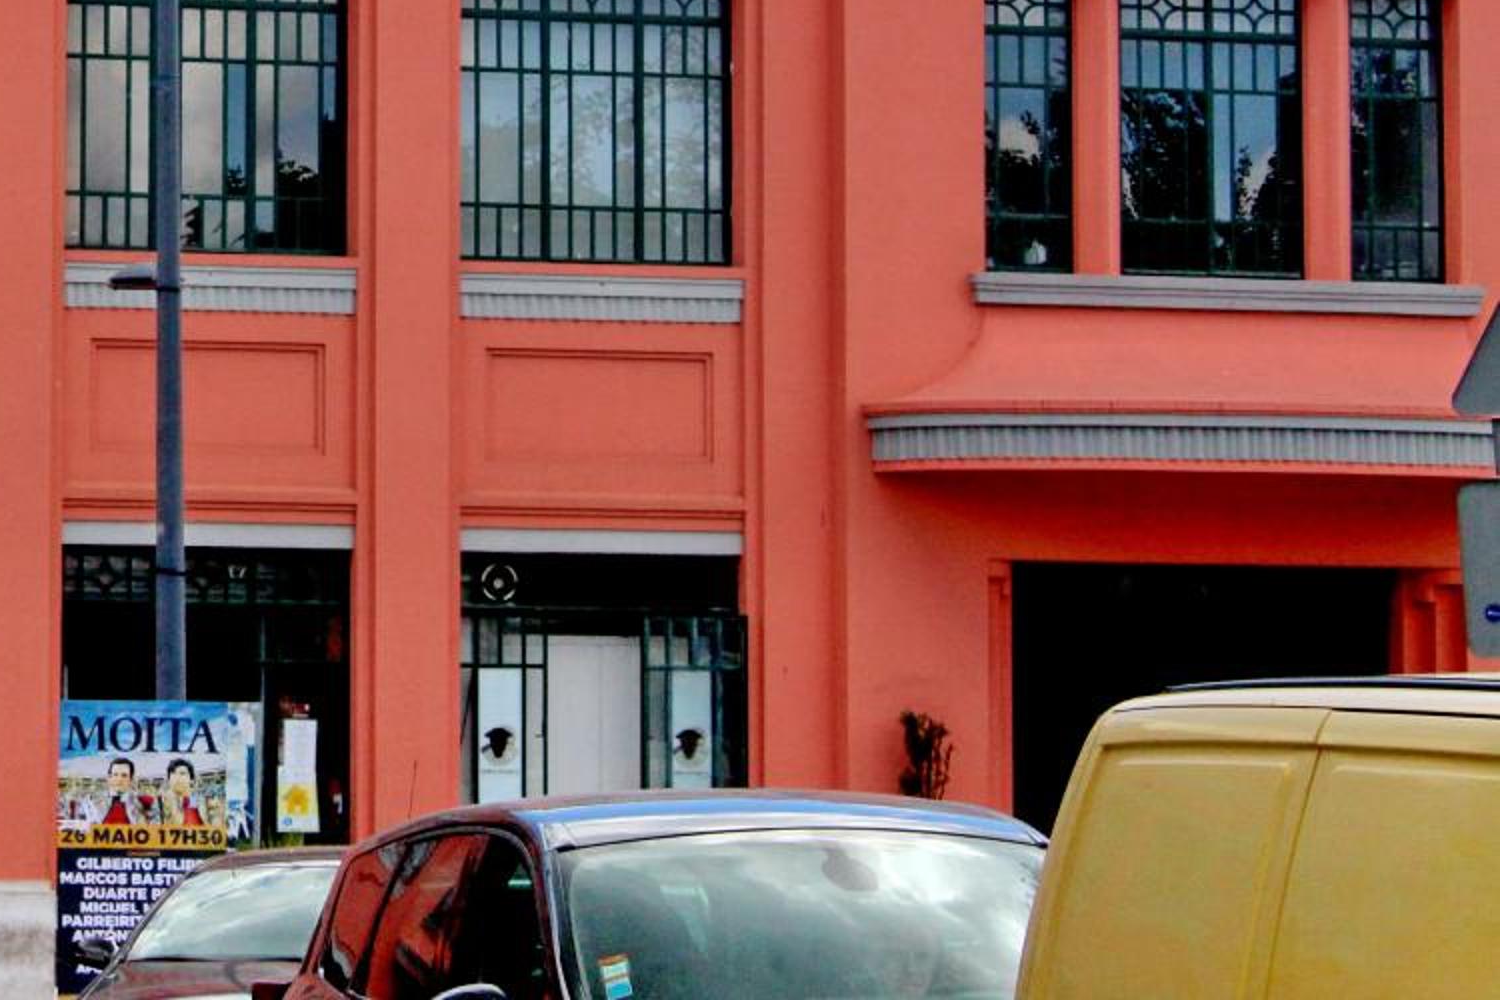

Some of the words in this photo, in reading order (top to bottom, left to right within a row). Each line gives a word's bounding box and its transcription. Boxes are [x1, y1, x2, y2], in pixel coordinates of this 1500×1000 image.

[66, 714, 220, 754] MOITA
[60, 829, 86, 844] 26
[92, 829, 150, 845] MAIO
[158, 829, 224, 845] 17H30
[76, 857, 154, 871] GILBERTO
[59, 872, 128, 885] MARCOS
[83, 887, 148, 901] DUARTE
[79, 901, 140, 914] MIGUEL
